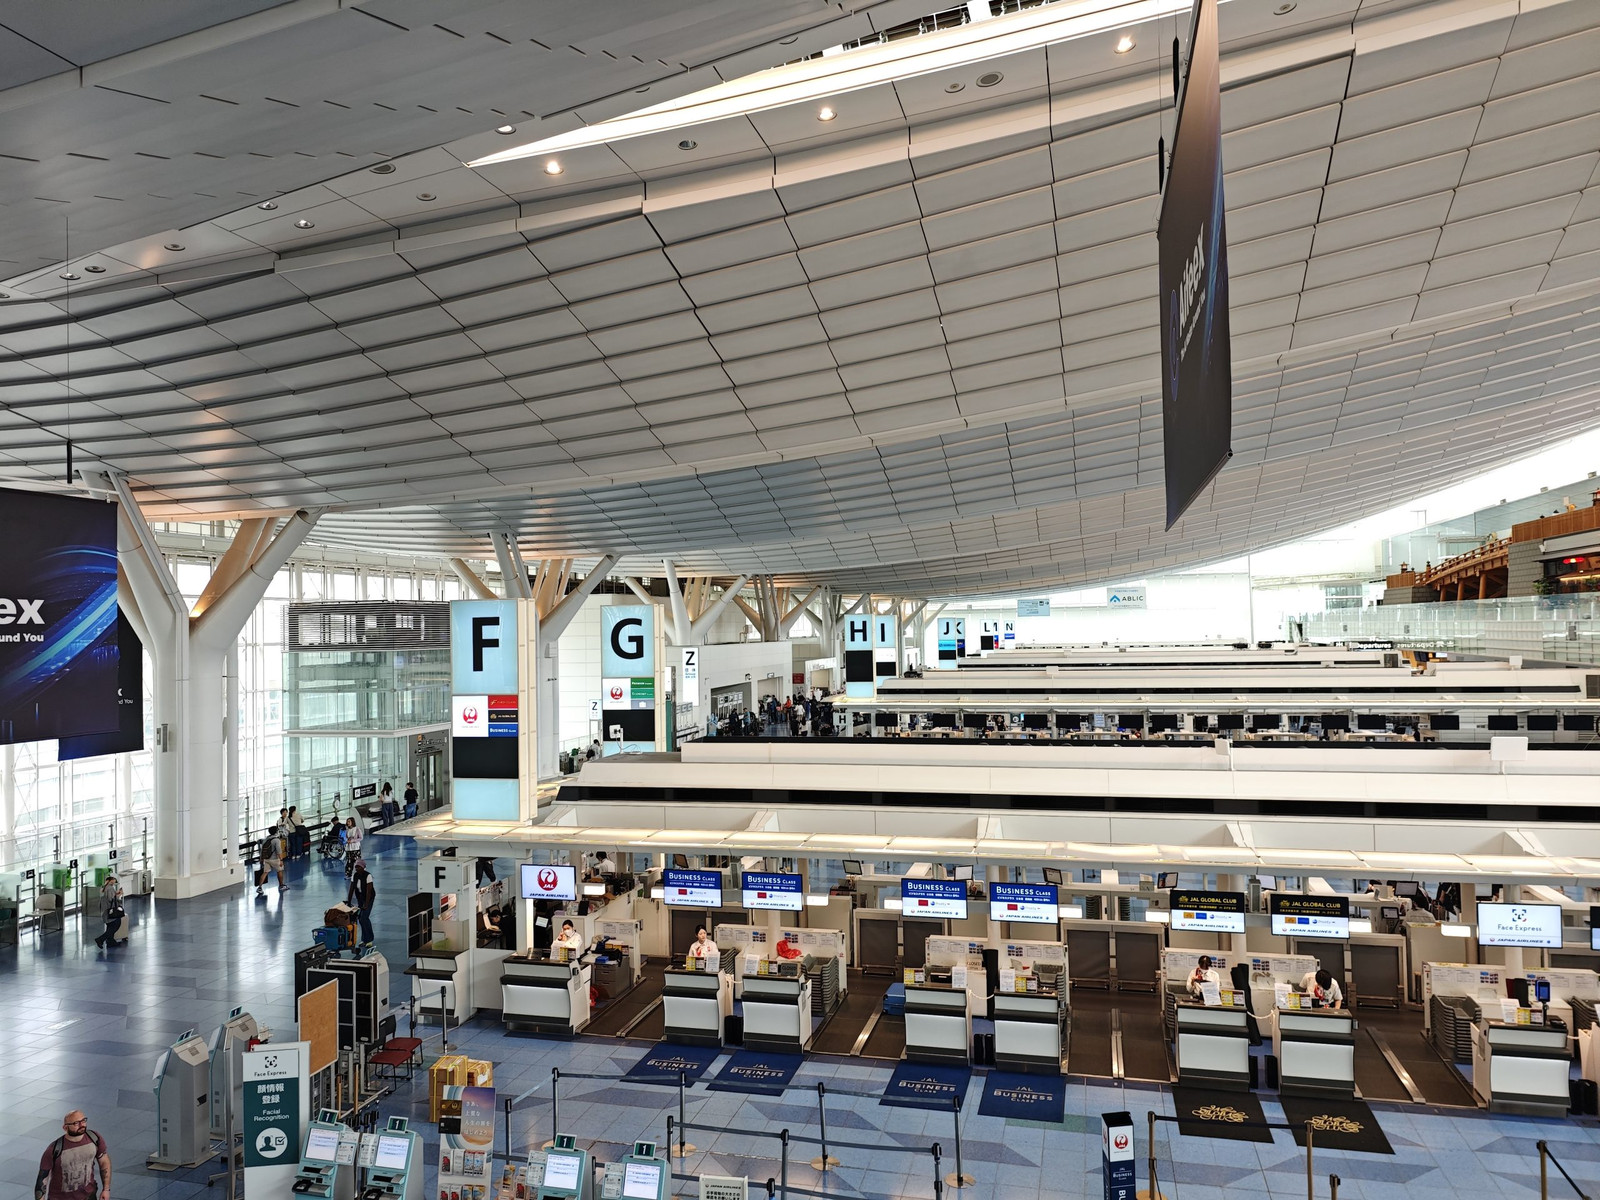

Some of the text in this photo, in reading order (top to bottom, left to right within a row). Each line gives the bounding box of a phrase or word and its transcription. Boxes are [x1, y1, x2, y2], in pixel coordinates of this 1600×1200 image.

[1180, 222, 1205, 338] Aifeex
[0, 598, 46, 624] ex
[850, 620, 867, 642] H
[944, 622, 950, 635] J
[984, 622, 990, 632] L
[1006, 623, 1013, 631] N
[880, 623, 885, 642] I
[23, 634, 44, 642] You
[610, 618, 644, 660] G
[472, 617, 500, 672] F
[686, 651, 695, 666] Z
[592, 702, 598, 710] Z
[839, 715, 846, 724] H
[434, 866, 446, 888] F
[668, 872, 701, 881] BUSINESS
[748, 875, 781, 884] BUSINESS
[908, 882, 944, 891] BUSINESS
[996, 886, 1034, 895] BUSINESS
[646, 1060, 698, 1070] BUSINESS
[729, 1067, 785, 1077] BUSINESS
[257, 1083, 284, 1094] 顔情報
[898, 1080, 956, 1092] BUSINESS
[262, 1094, 280, 1105] 登録
[993, 1089, 1053, 1101] BUSINESS
[254, 1114, 290, 1122] Recognition
[326, 1113, 330, 1122] 1
[395, 1121, 399, 1129] 1
[563, 1137, 567, 1147] 1
[643, 1145, 647, 1155] 1
